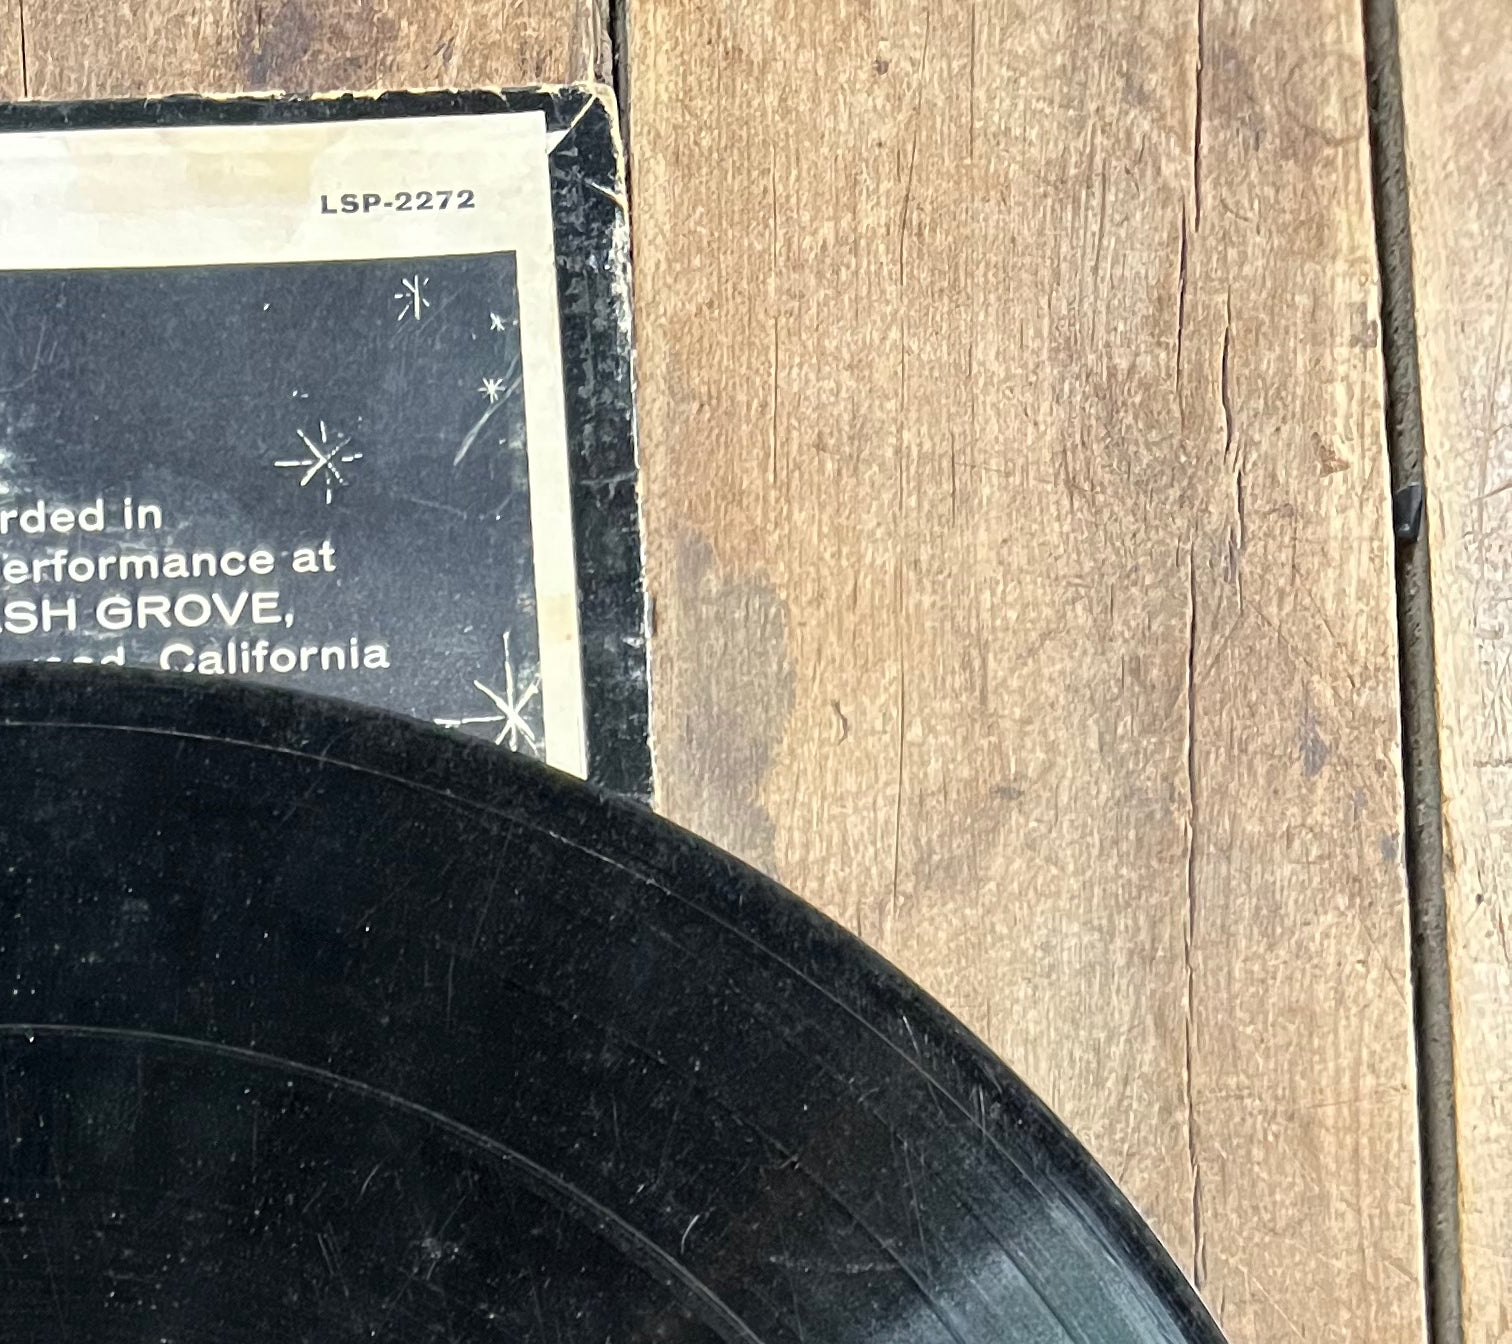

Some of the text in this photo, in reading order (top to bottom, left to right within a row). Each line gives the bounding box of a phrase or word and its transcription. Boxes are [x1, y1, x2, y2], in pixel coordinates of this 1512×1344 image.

[320, 188, 477, 215] LSP-2272
[124, 498, 162, 531] in
[292, 541, 337, 574] at
[96, 592, 296, 631] GROVE,
[158, 638, 391, 676] California
